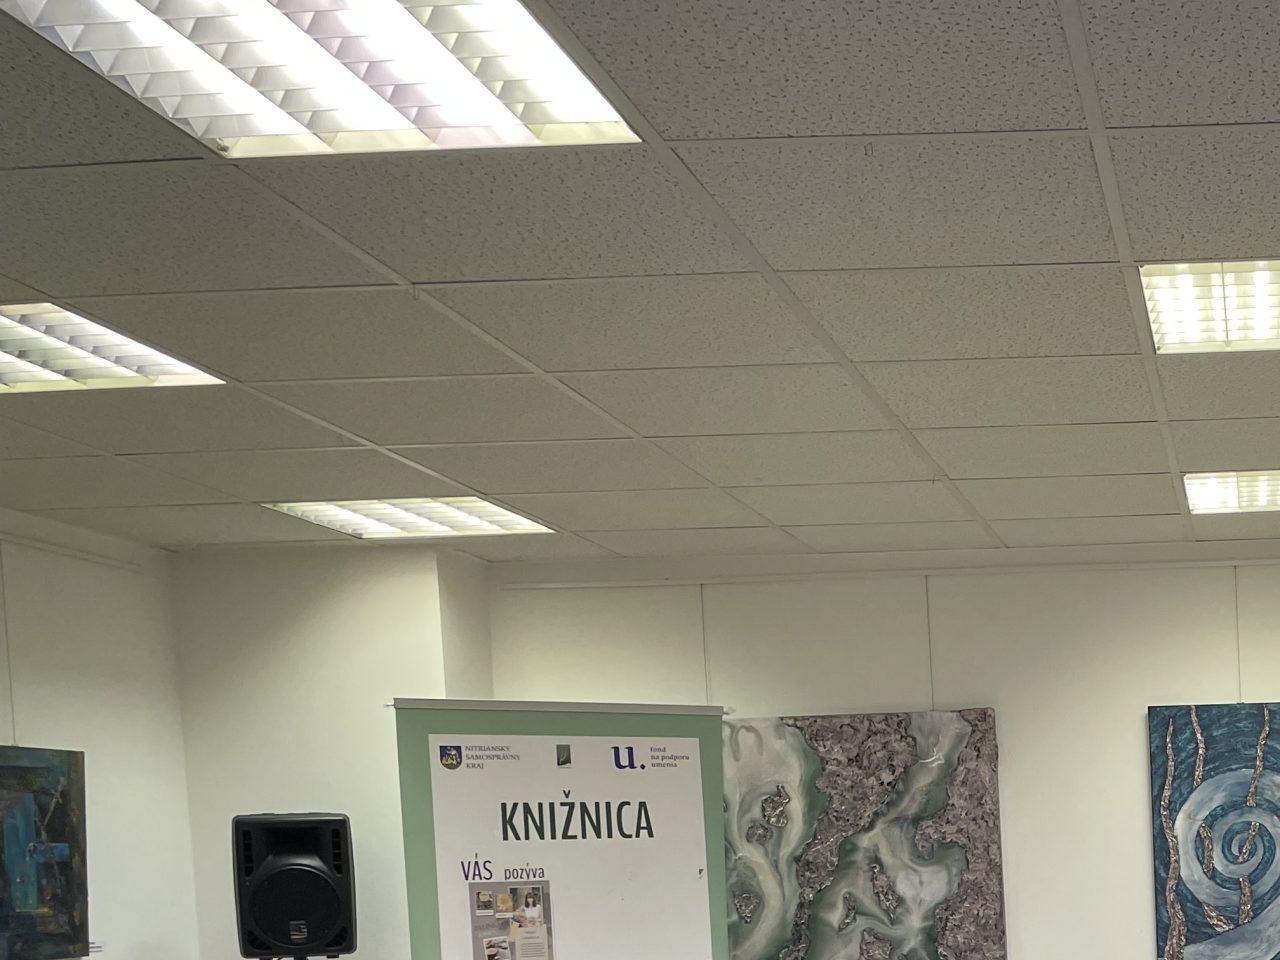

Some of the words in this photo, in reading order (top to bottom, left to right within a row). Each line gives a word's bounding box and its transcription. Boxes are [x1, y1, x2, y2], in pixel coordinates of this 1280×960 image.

[501, 789, 654, 841] KNIŽNICA
[460, 853, 493, 881] VÁS
[504, 863, 545, 880] pozýva
